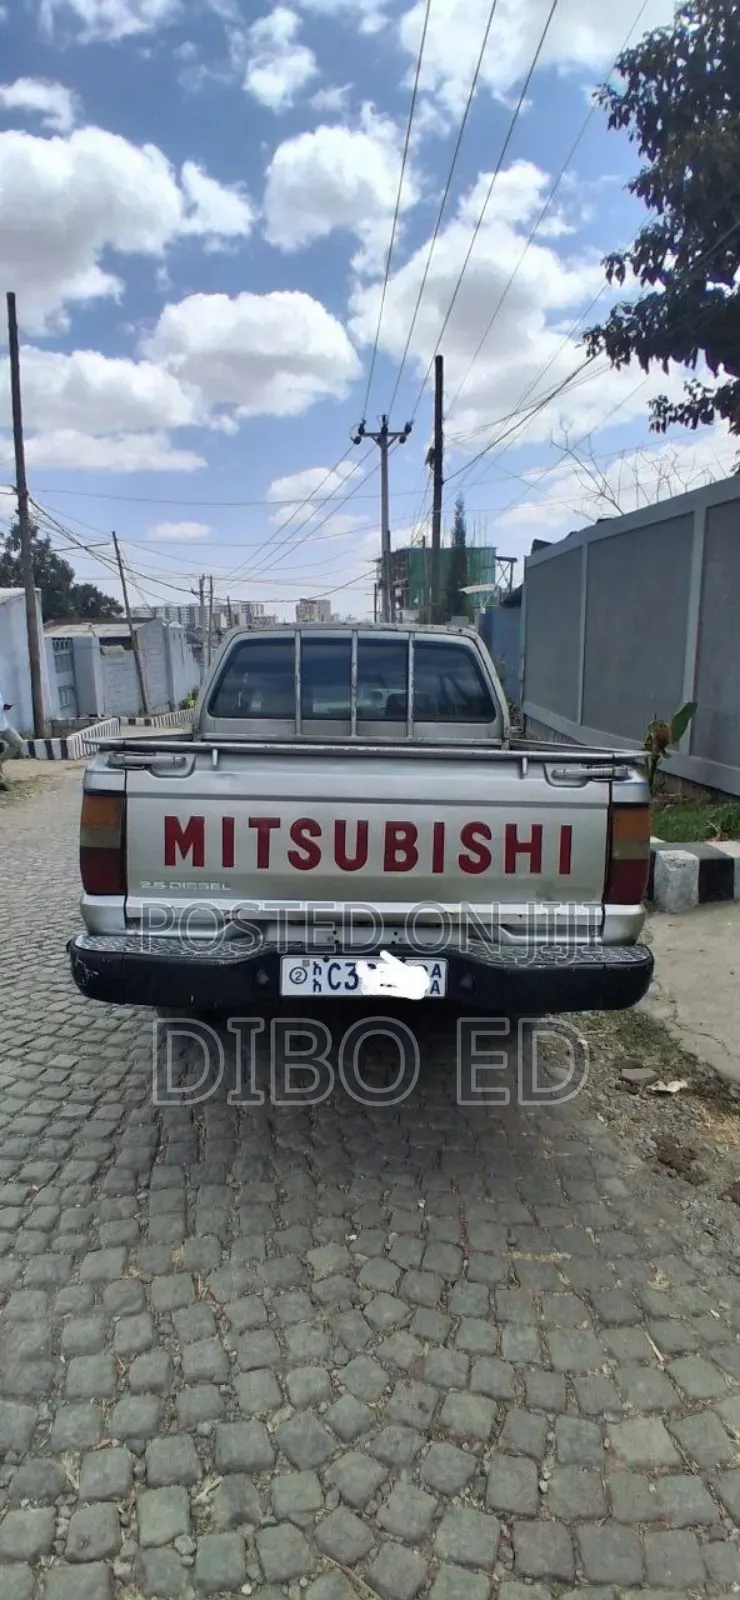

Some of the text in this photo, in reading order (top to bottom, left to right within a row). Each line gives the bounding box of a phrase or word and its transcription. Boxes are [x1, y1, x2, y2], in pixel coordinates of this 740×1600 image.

[164, 815, 572, 875] MITSUBISHI
[140, 881, 231, 891] 2.5 DIESEL
